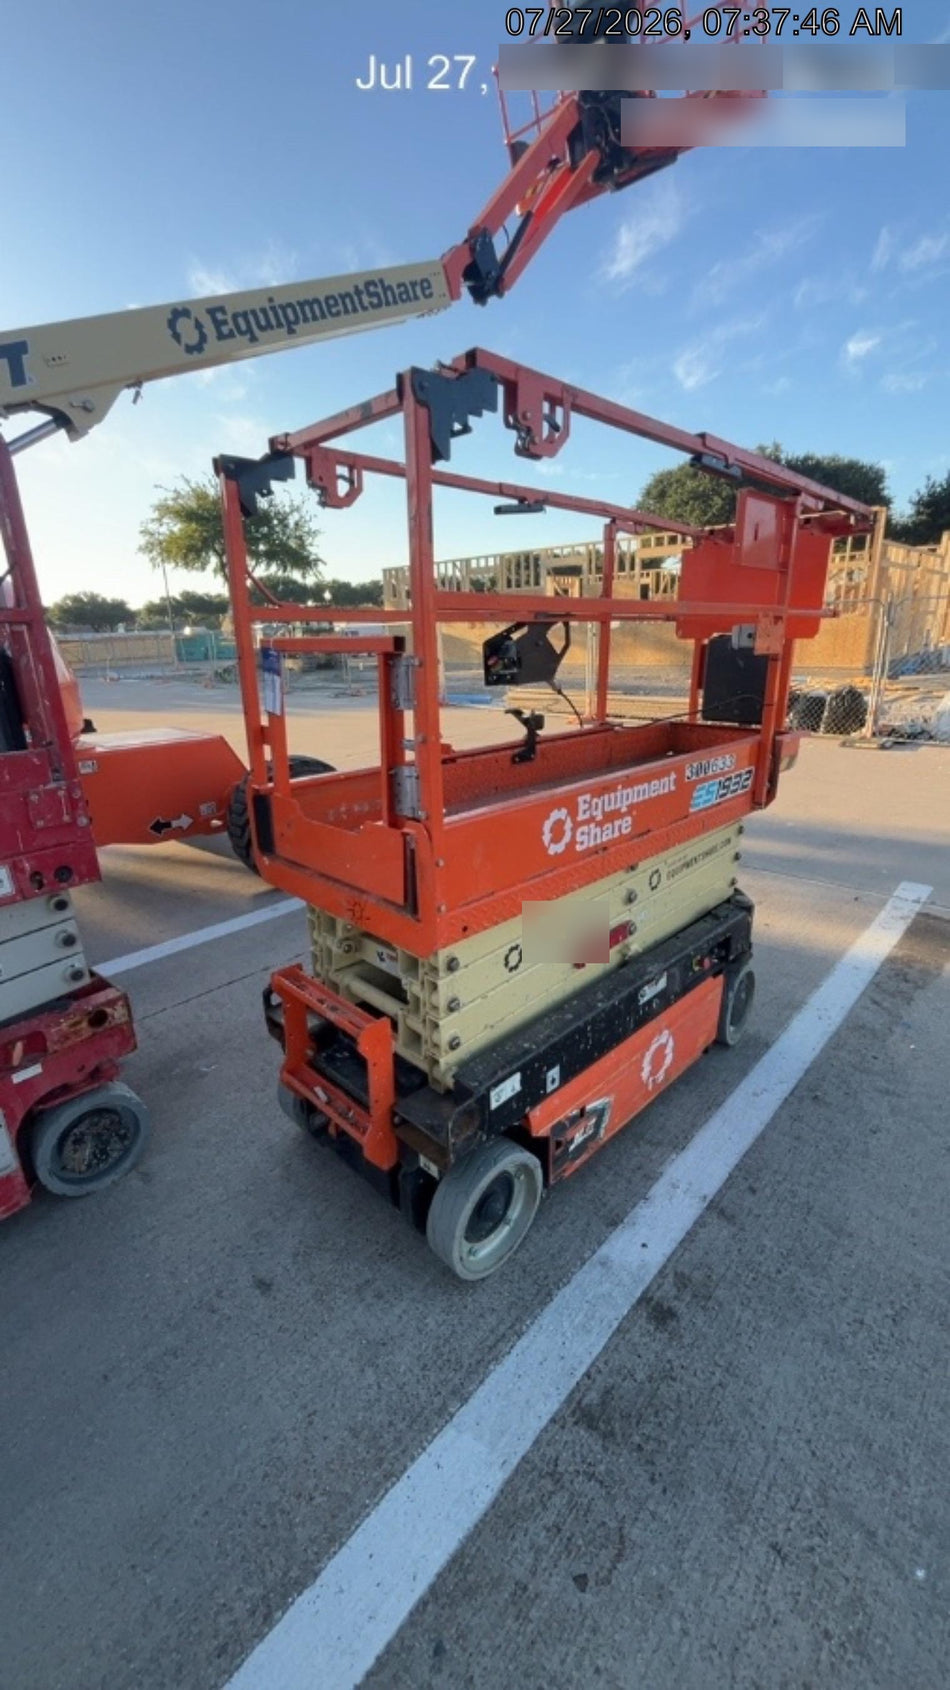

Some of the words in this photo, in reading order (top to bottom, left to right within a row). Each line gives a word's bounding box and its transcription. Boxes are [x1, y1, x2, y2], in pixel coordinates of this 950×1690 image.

[205, 275, 434, 343] EquipmentShare
[576, 771, 677, 823] Equipment
[575, 814, 632, 852] Share
